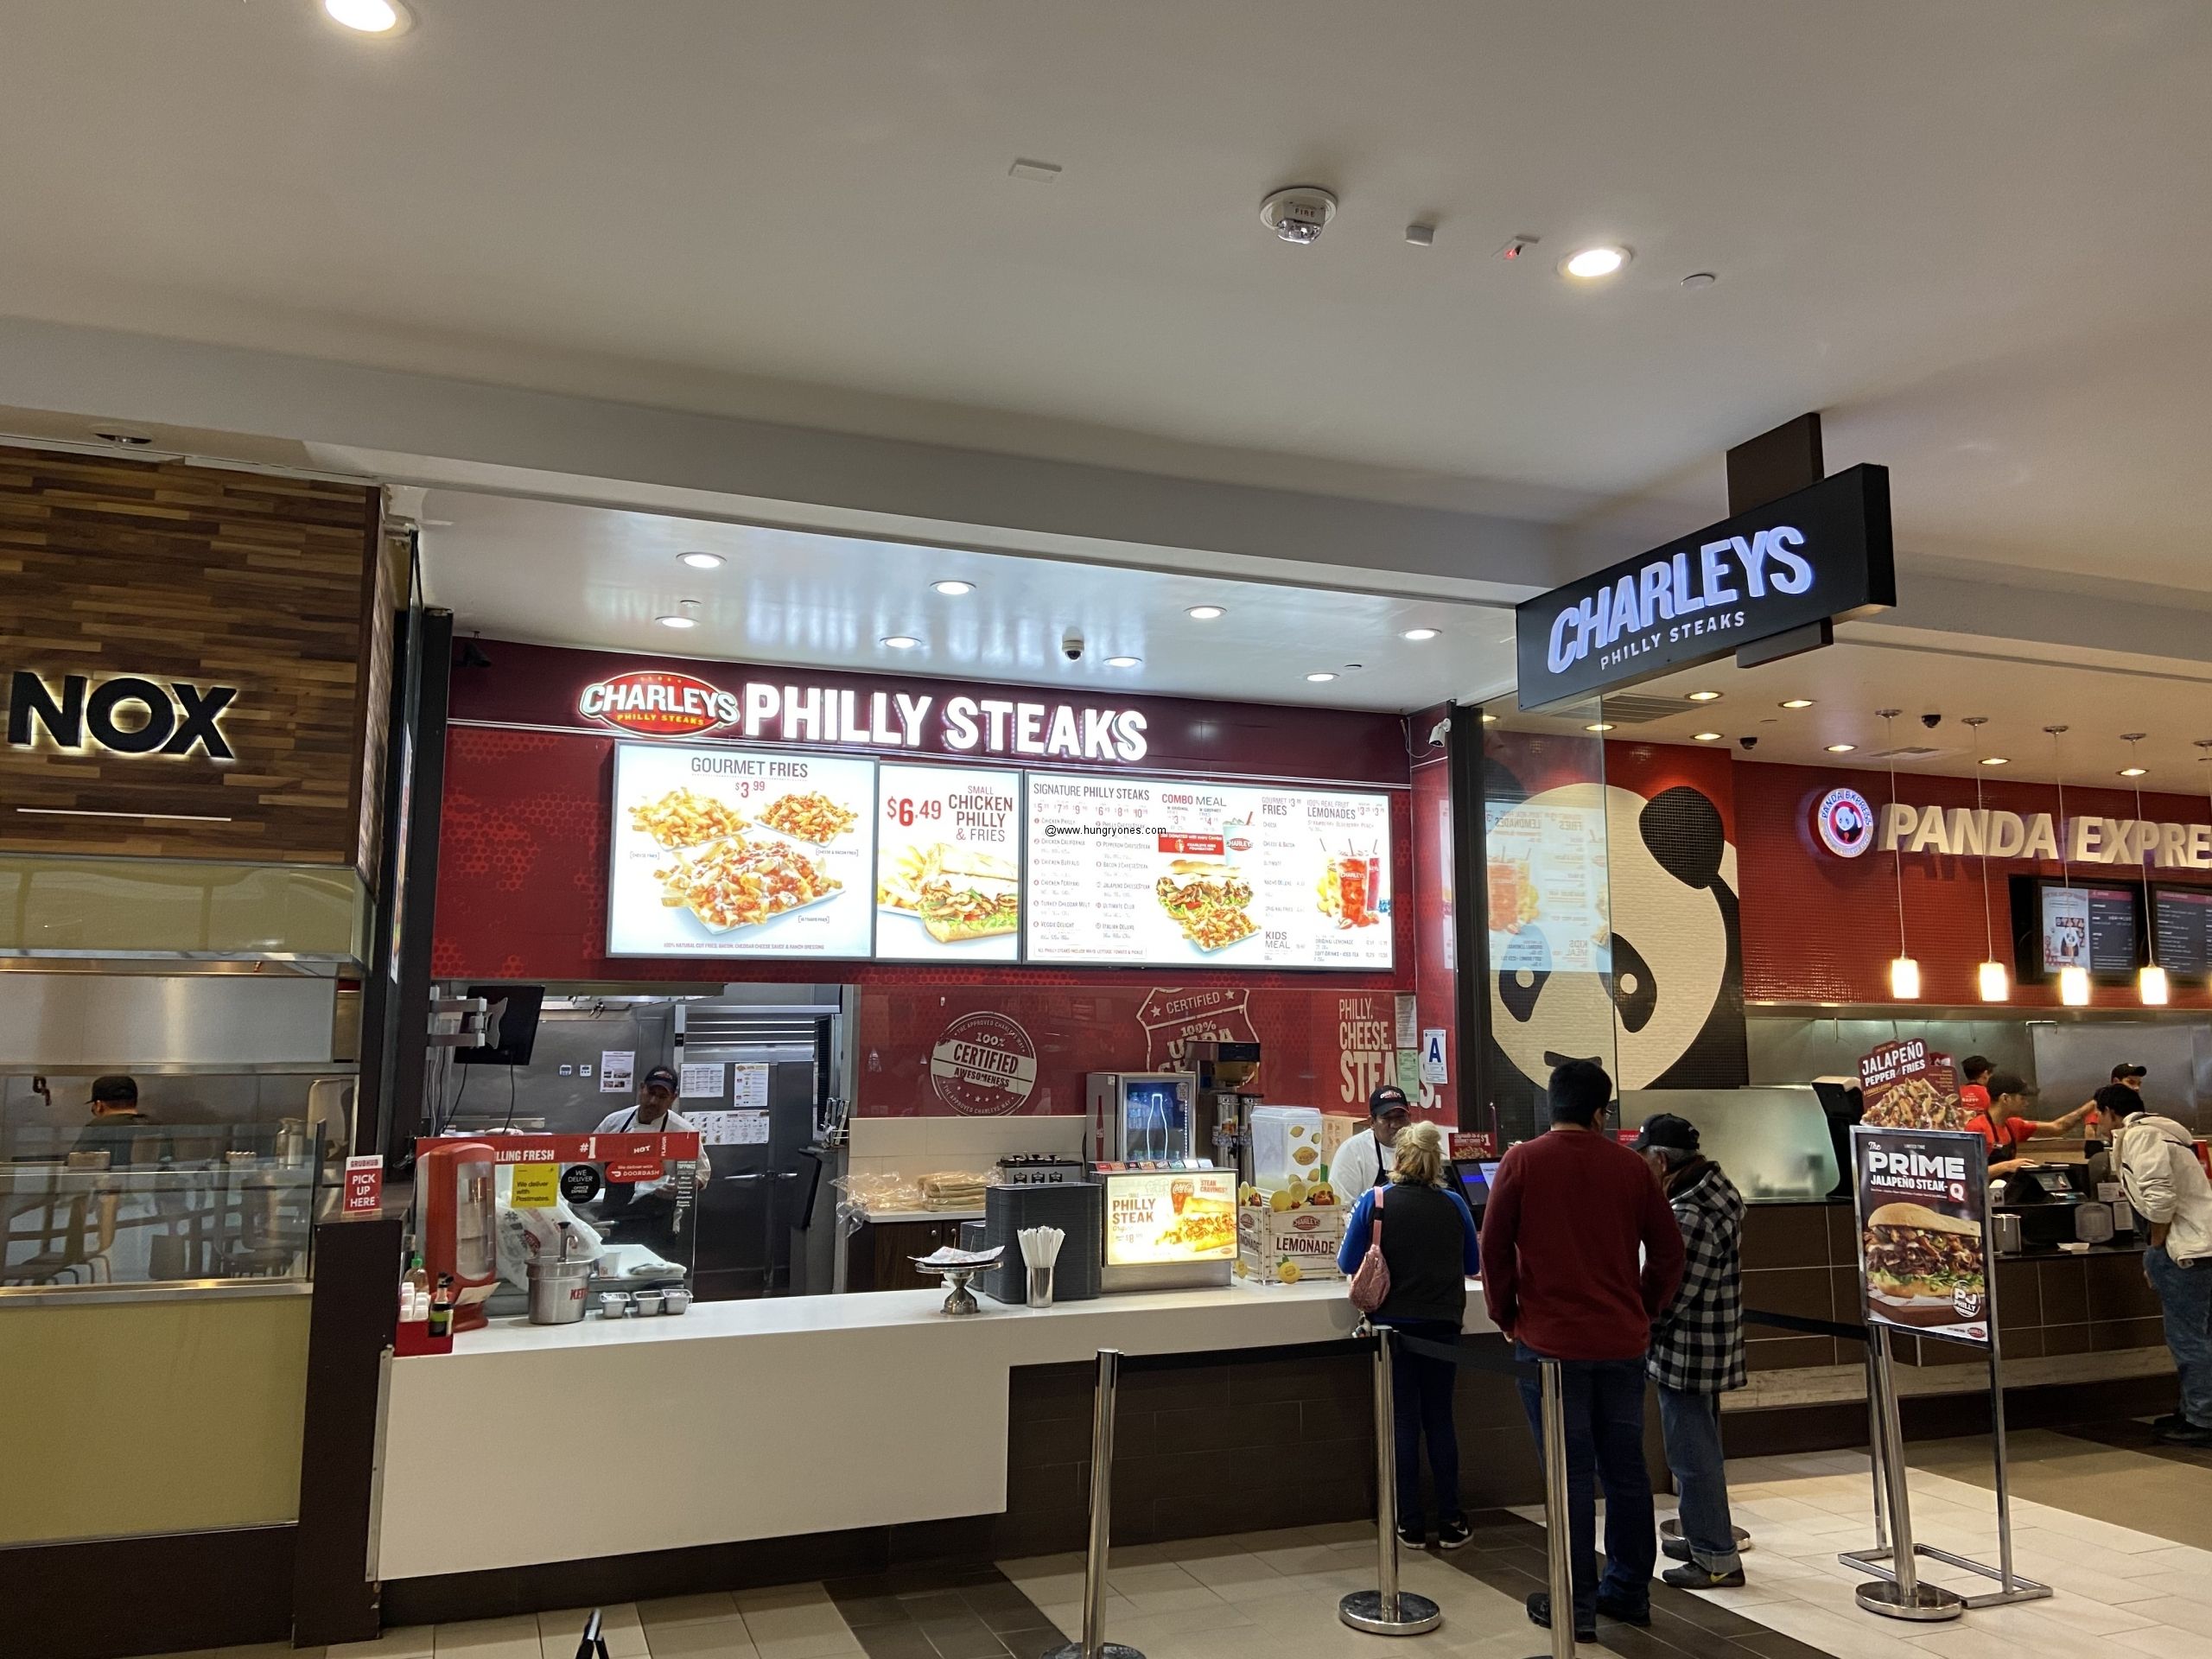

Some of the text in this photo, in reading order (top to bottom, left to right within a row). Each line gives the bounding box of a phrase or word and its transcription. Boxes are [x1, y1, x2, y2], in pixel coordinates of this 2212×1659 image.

[1294, 207, 1315, 217] FIRE
[1548, 525, 1813, 674] CHARLEYS
[1600, 611, 1745, 671] PHILLY STEAKS
[580, 683, 740, 724] CHARLEYS
[8, 671, 237, 759] NOX
[617, 713, 704, 726] PHILLY STEAKS
[744, 683, 1148, 762] PHILLY STEAKS
[691, 757, 808, 778] GOURMET FRIES
[734, 781, 765, 798] $3.99
[967, 785, 994, 795] SMALL
[1033, 783, 1150, 801] SIGNATURE PHILLY STEAKS
[948, 794, 1013, 811] CHICKEN
[1161, 793, 1227, 807] COMBO MEAL
[1821, 791, 1872, 826] PANDA EXPRESS
[887, 796, 942, 827] $6.49
[1262, 804, 1287, 816] FRIES
[1307, 807, 1356, 820] LEMONADES
[957, 811, 1006, 828] PHILLY
[956, 828, 1005, 842] & FRIES
[1882, 803, 2060, 860] PANDA
[1265, 931, 1287, 940] KIDS
[1265, 940, 1291, 950] MEAL
[1166, 992, 1220, 1014] CERTIFIED
[1339, 998, 1374, 1020] PHILLY.
[968, 1020, 994, 1028] APPROVED
[1180, 1020, 1217, 1038] 100%
[976, 1032, 1005, 1047] 100%
[1339, 1021, 1392, 1051] CHEESE.
[1429, 1037, 1442, 1063] A
[1862, 1041, 1924, 1076] JALAPEÑO
[954, 1044, 1019, 1075] CERTIFIED
[954, 1067, 1010, 1088] AWESOMENESS
[1341, 1050, 1442, 1109] STEAS.
[1865, 1059, 1926, 1087] PEPPER FRIES
[950, 1095, 974, 1113] APPROVED
[580, 1137, 596, 1160] #1
[1481, 1134, 1491, 1146] $1
[1868, 1141, 1881, 1151] The
[524, 1149, 555, 1161] FRESH
[634, 1146, 651, 1154] HOT
[1868, 1151, 1966, 1180] PRIME
[353, 1174, 376, 1185] PICK
[1871, 1175, 1916, 1189] JALAPEÑO
[356, 1185, 371, 1196] UP
[350, 1197, 376, 1208] HERE
[1113, 1198, 1156, 1211] PHILLY
[1112, 1211, 1154, 1225] STEAK
[1276, 1236, 1335, 1255] LEMONADE
